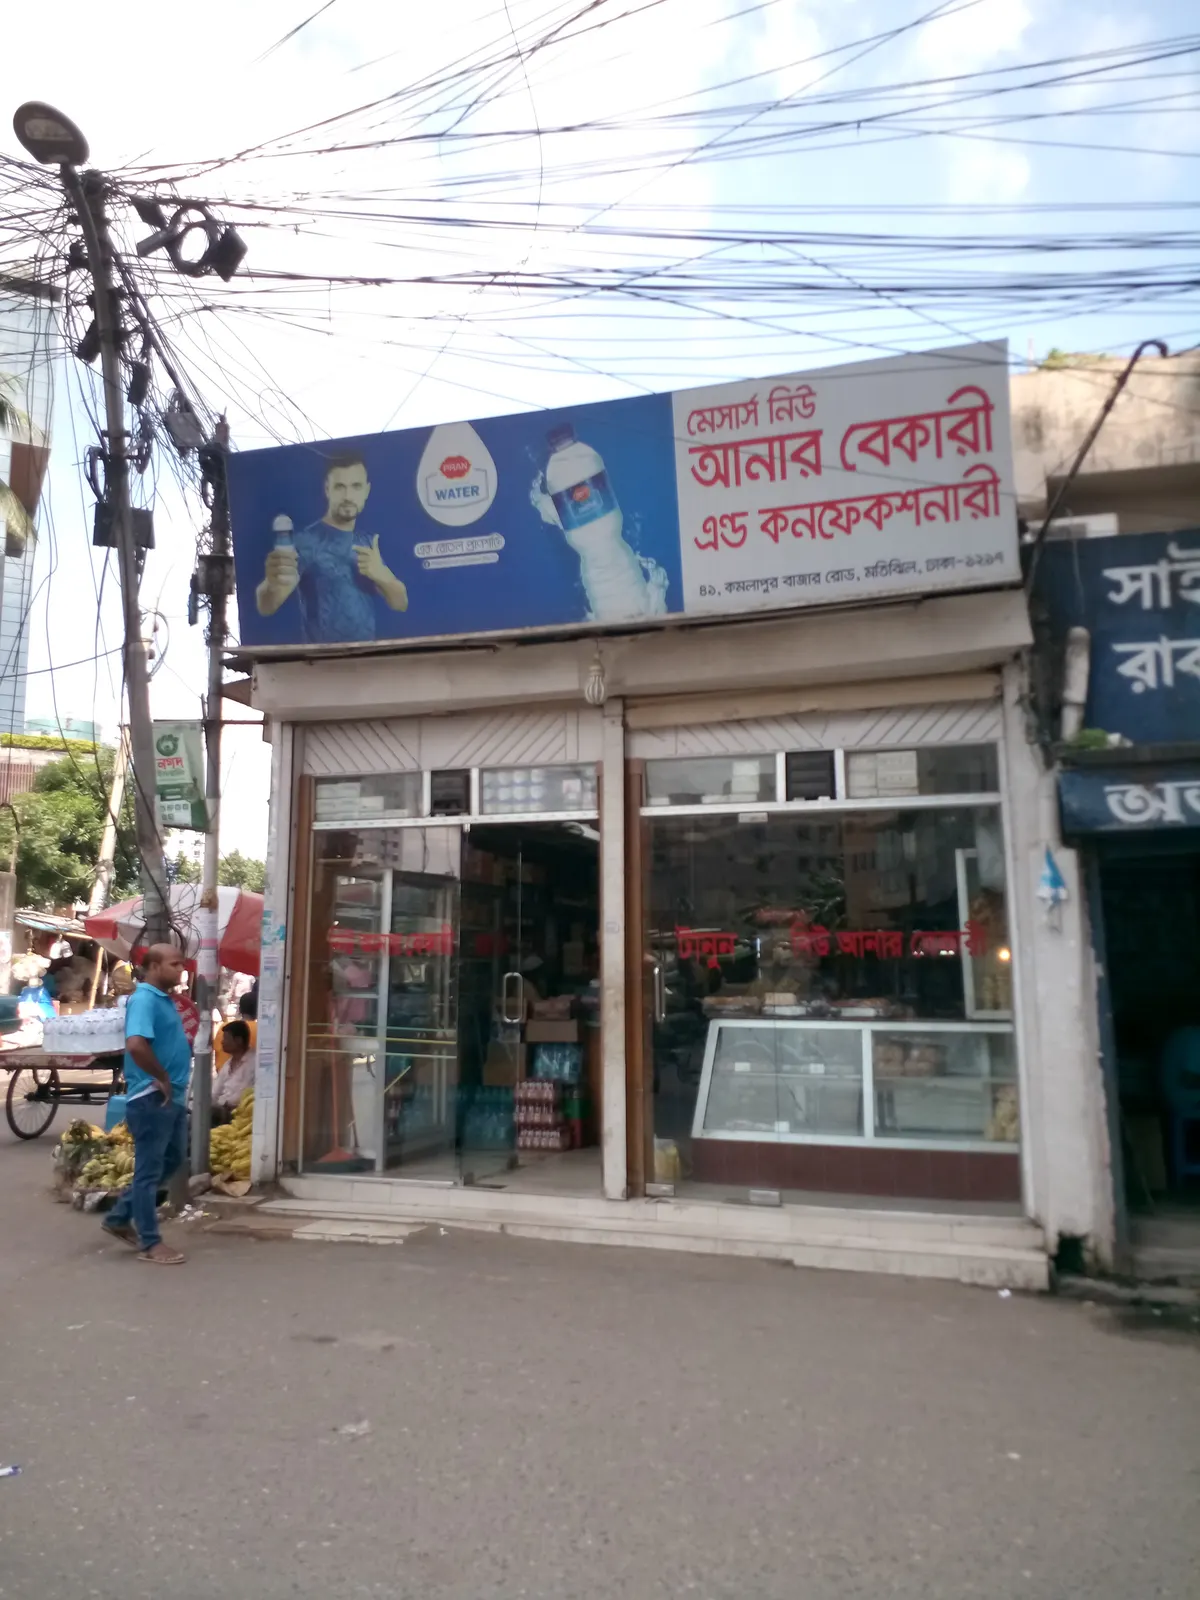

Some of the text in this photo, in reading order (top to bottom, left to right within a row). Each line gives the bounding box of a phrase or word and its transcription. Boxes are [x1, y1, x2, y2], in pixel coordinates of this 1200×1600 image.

[687, 384, 818, 436] মেসার্স নিউ
[688, 385, 994, 489] আনার বেকারী
[435, 485, 480, 501] WATER
[758, 463, 1002, 544] কনফেকশনারী
[782, 571, 822, 588] বাজার
